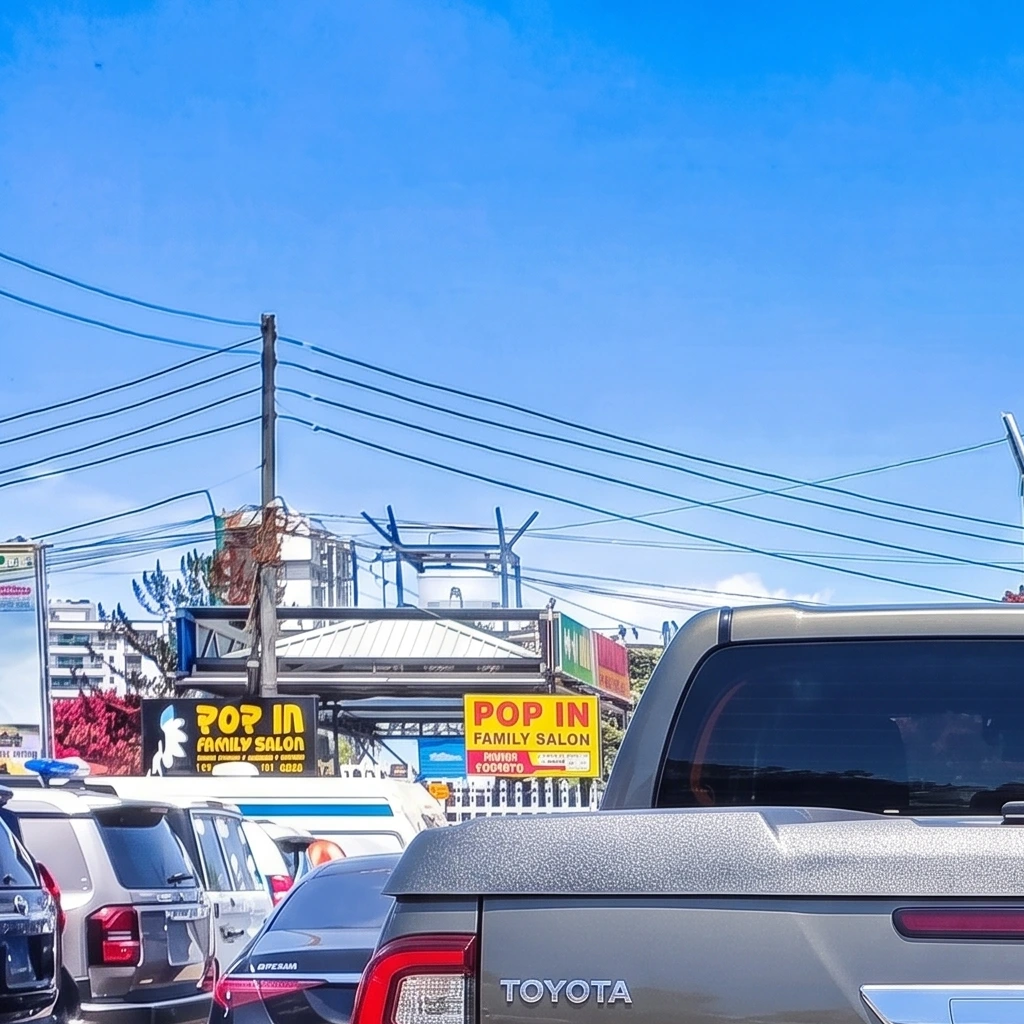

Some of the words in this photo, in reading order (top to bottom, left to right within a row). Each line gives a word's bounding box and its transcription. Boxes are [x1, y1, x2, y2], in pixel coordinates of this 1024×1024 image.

[474, 701, 543, 727] POP
[556, 702, 589, 727] IN
[197, 737, 252, 752] FAMILY
[255, 736, 305, 752] SALON
[474, 732, 530, 745] FAMILY
[536, 733, 590, 746] SALON
[500, 979, 633, 1004] TOYOTA
